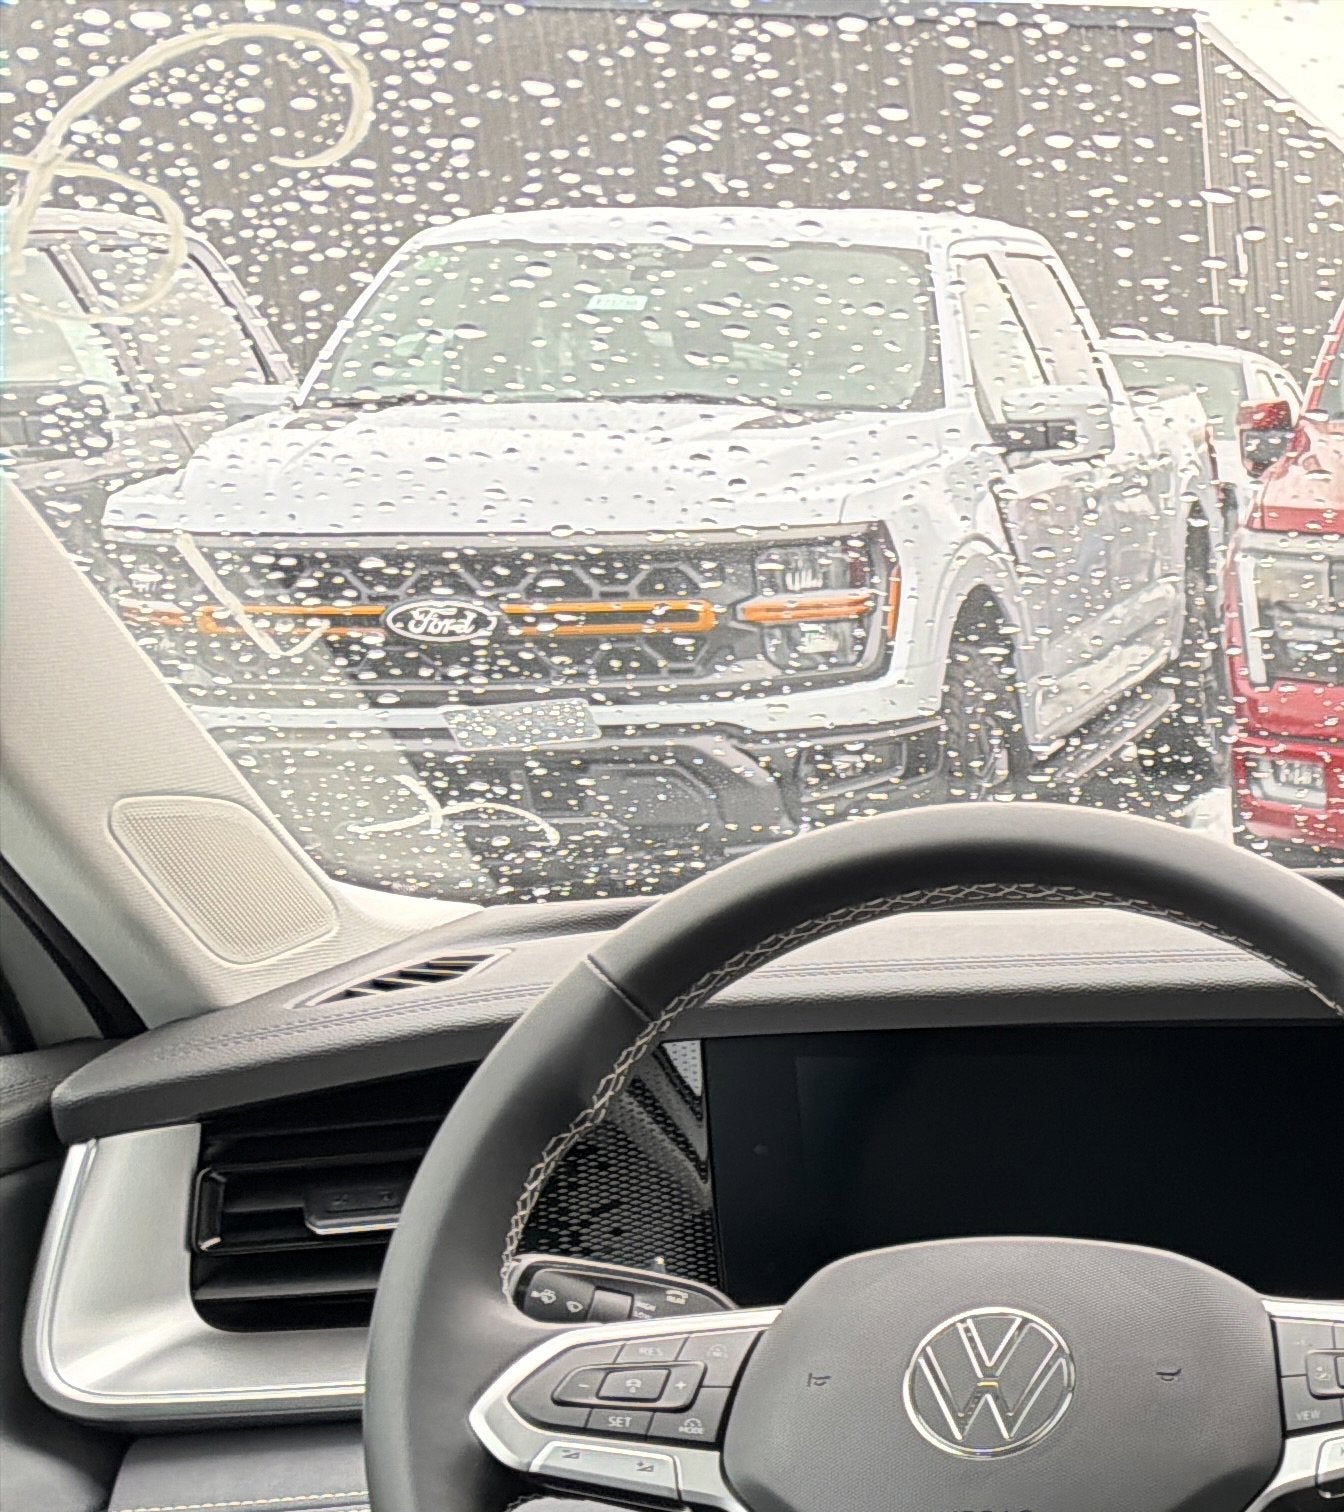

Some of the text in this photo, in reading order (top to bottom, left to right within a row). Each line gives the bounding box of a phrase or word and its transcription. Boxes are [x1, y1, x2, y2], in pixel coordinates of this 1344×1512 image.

[407, 606, 478, 634] Ford
[607, 1415, 633, 1428] SET
[678, 1425, 705, 1435] MODE
